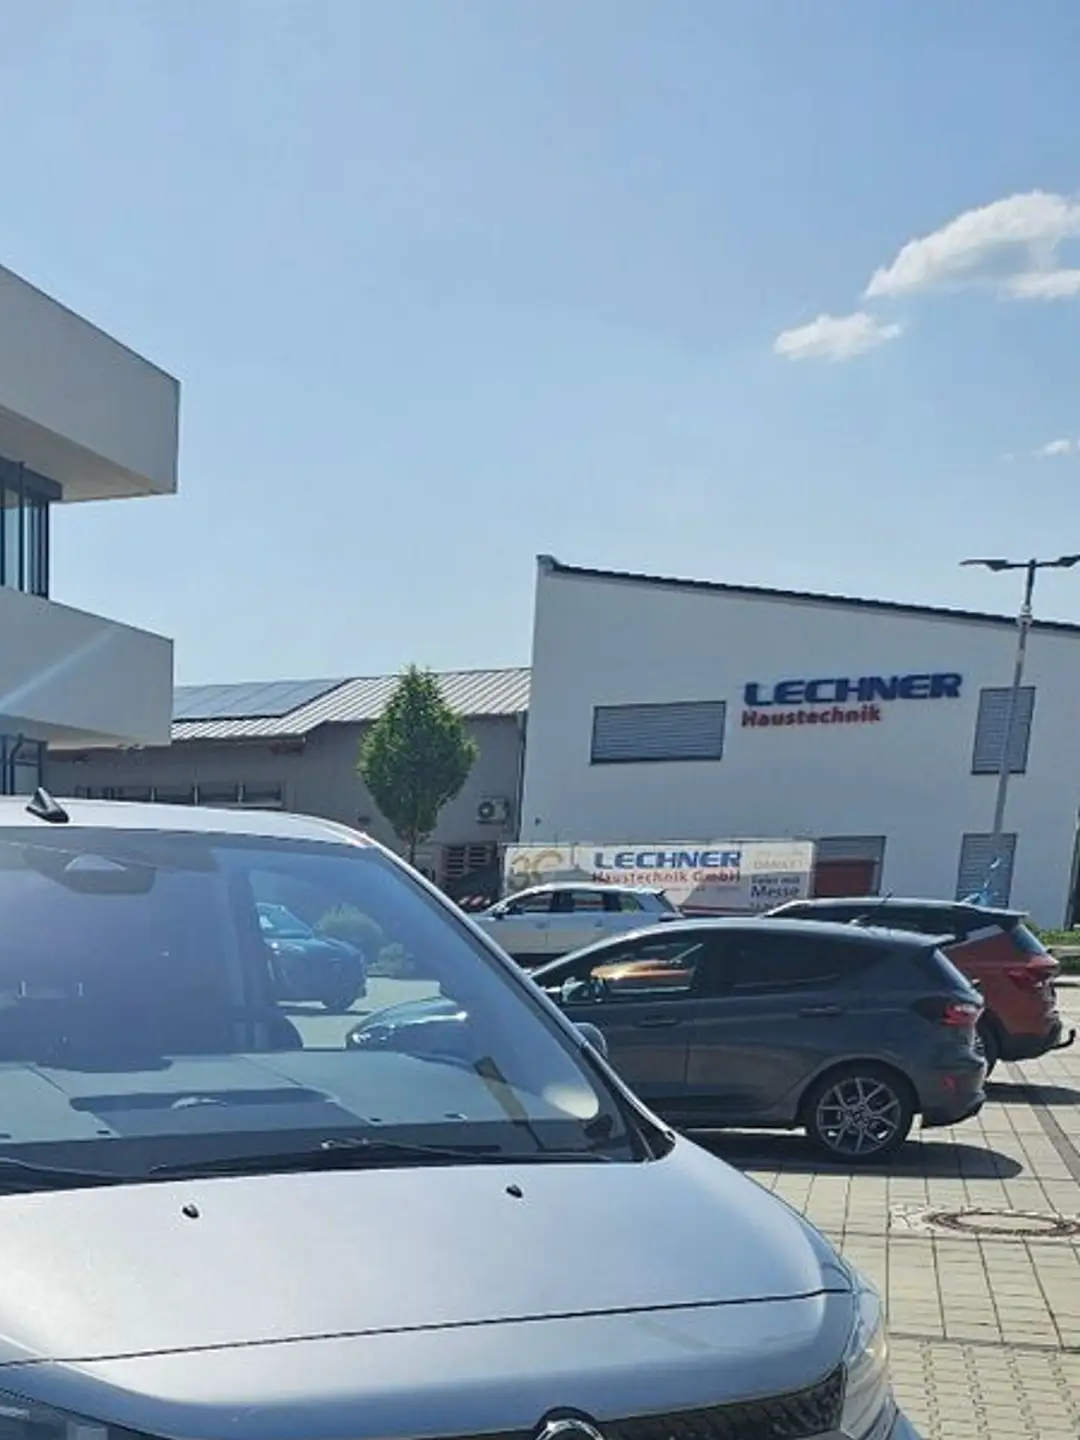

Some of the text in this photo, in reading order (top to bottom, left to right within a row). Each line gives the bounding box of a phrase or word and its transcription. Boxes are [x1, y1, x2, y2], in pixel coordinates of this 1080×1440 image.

[743, 672, 963, 706] LECHNER
[740, 704, 882, 728] Haustechnik
[593, 850, 742, 869] LECHNER
[591, 869, 741, 885] Haustechnik GmbH
[751, 885, 801, 898] Messe
